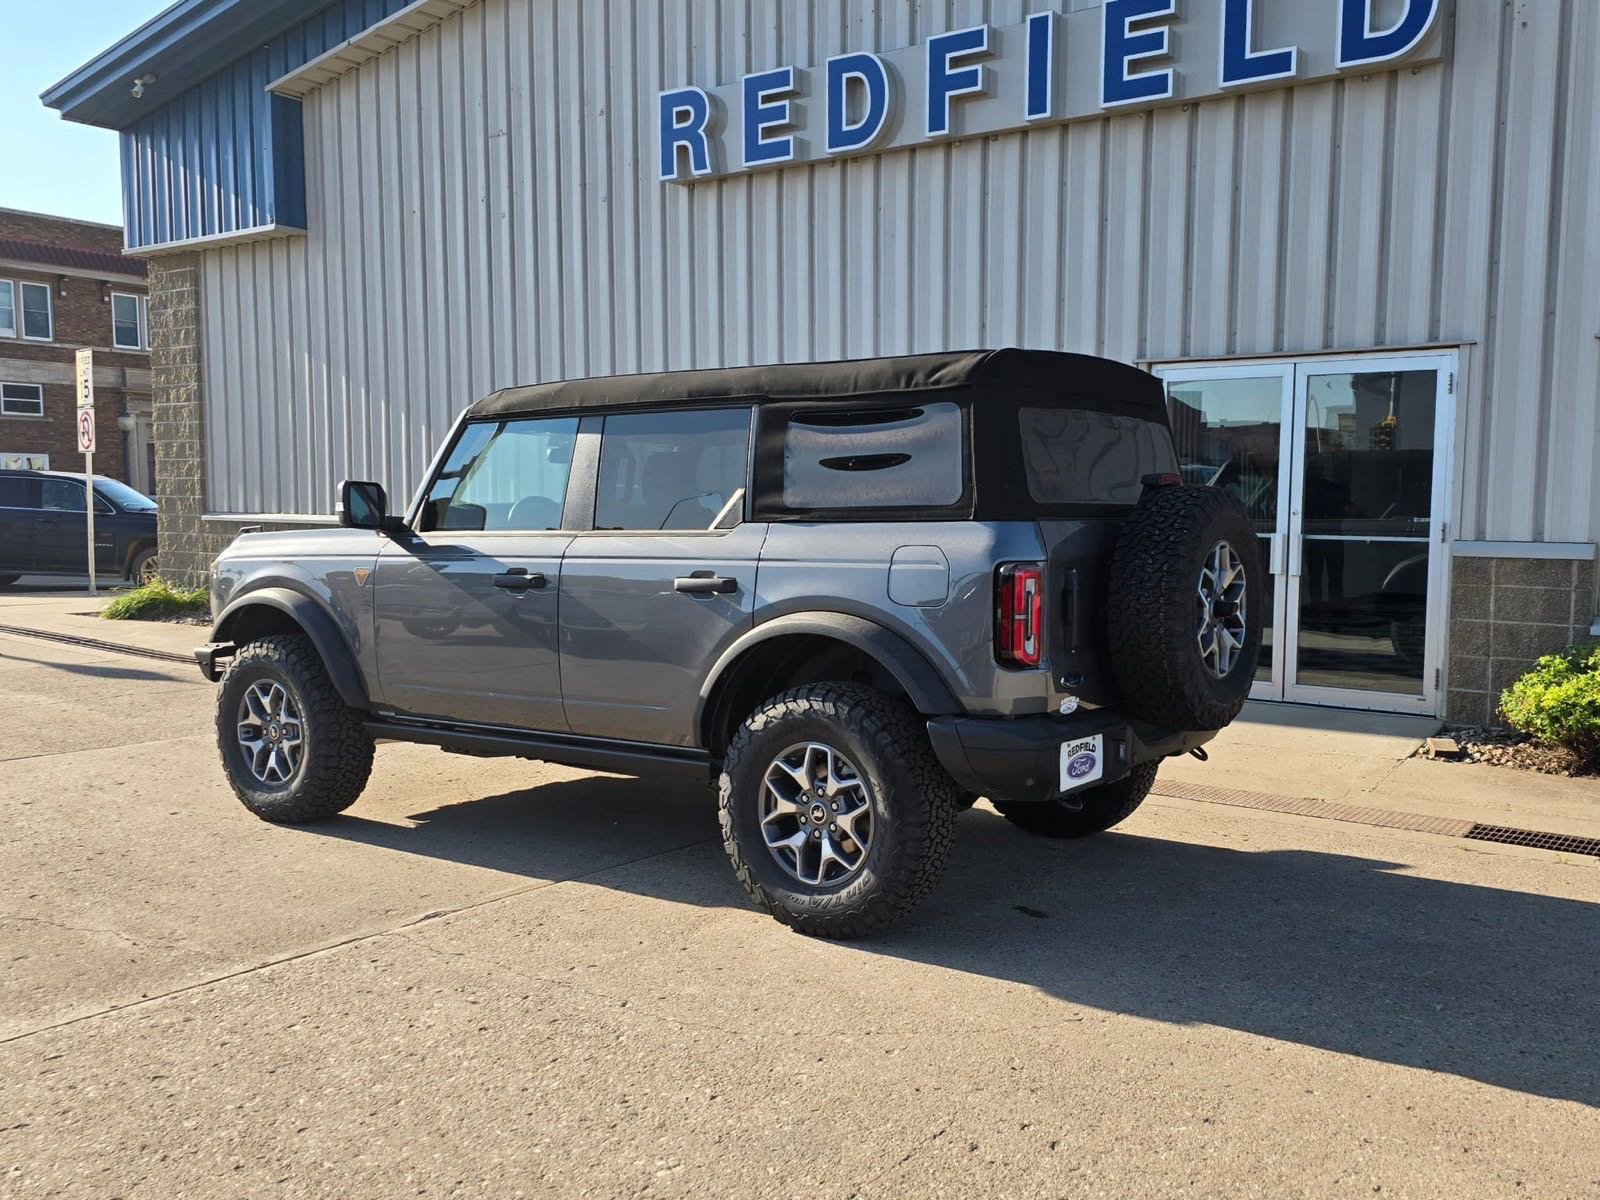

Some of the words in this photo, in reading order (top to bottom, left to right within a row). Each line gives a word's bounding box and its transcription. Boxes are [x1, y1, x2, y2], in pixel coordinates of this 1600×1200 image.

[658, 0, 1439, 181] REDFIELD
[1067, 742, 1096, 760] REDFIELD
[1071, 757, 1091, 776] Ford
